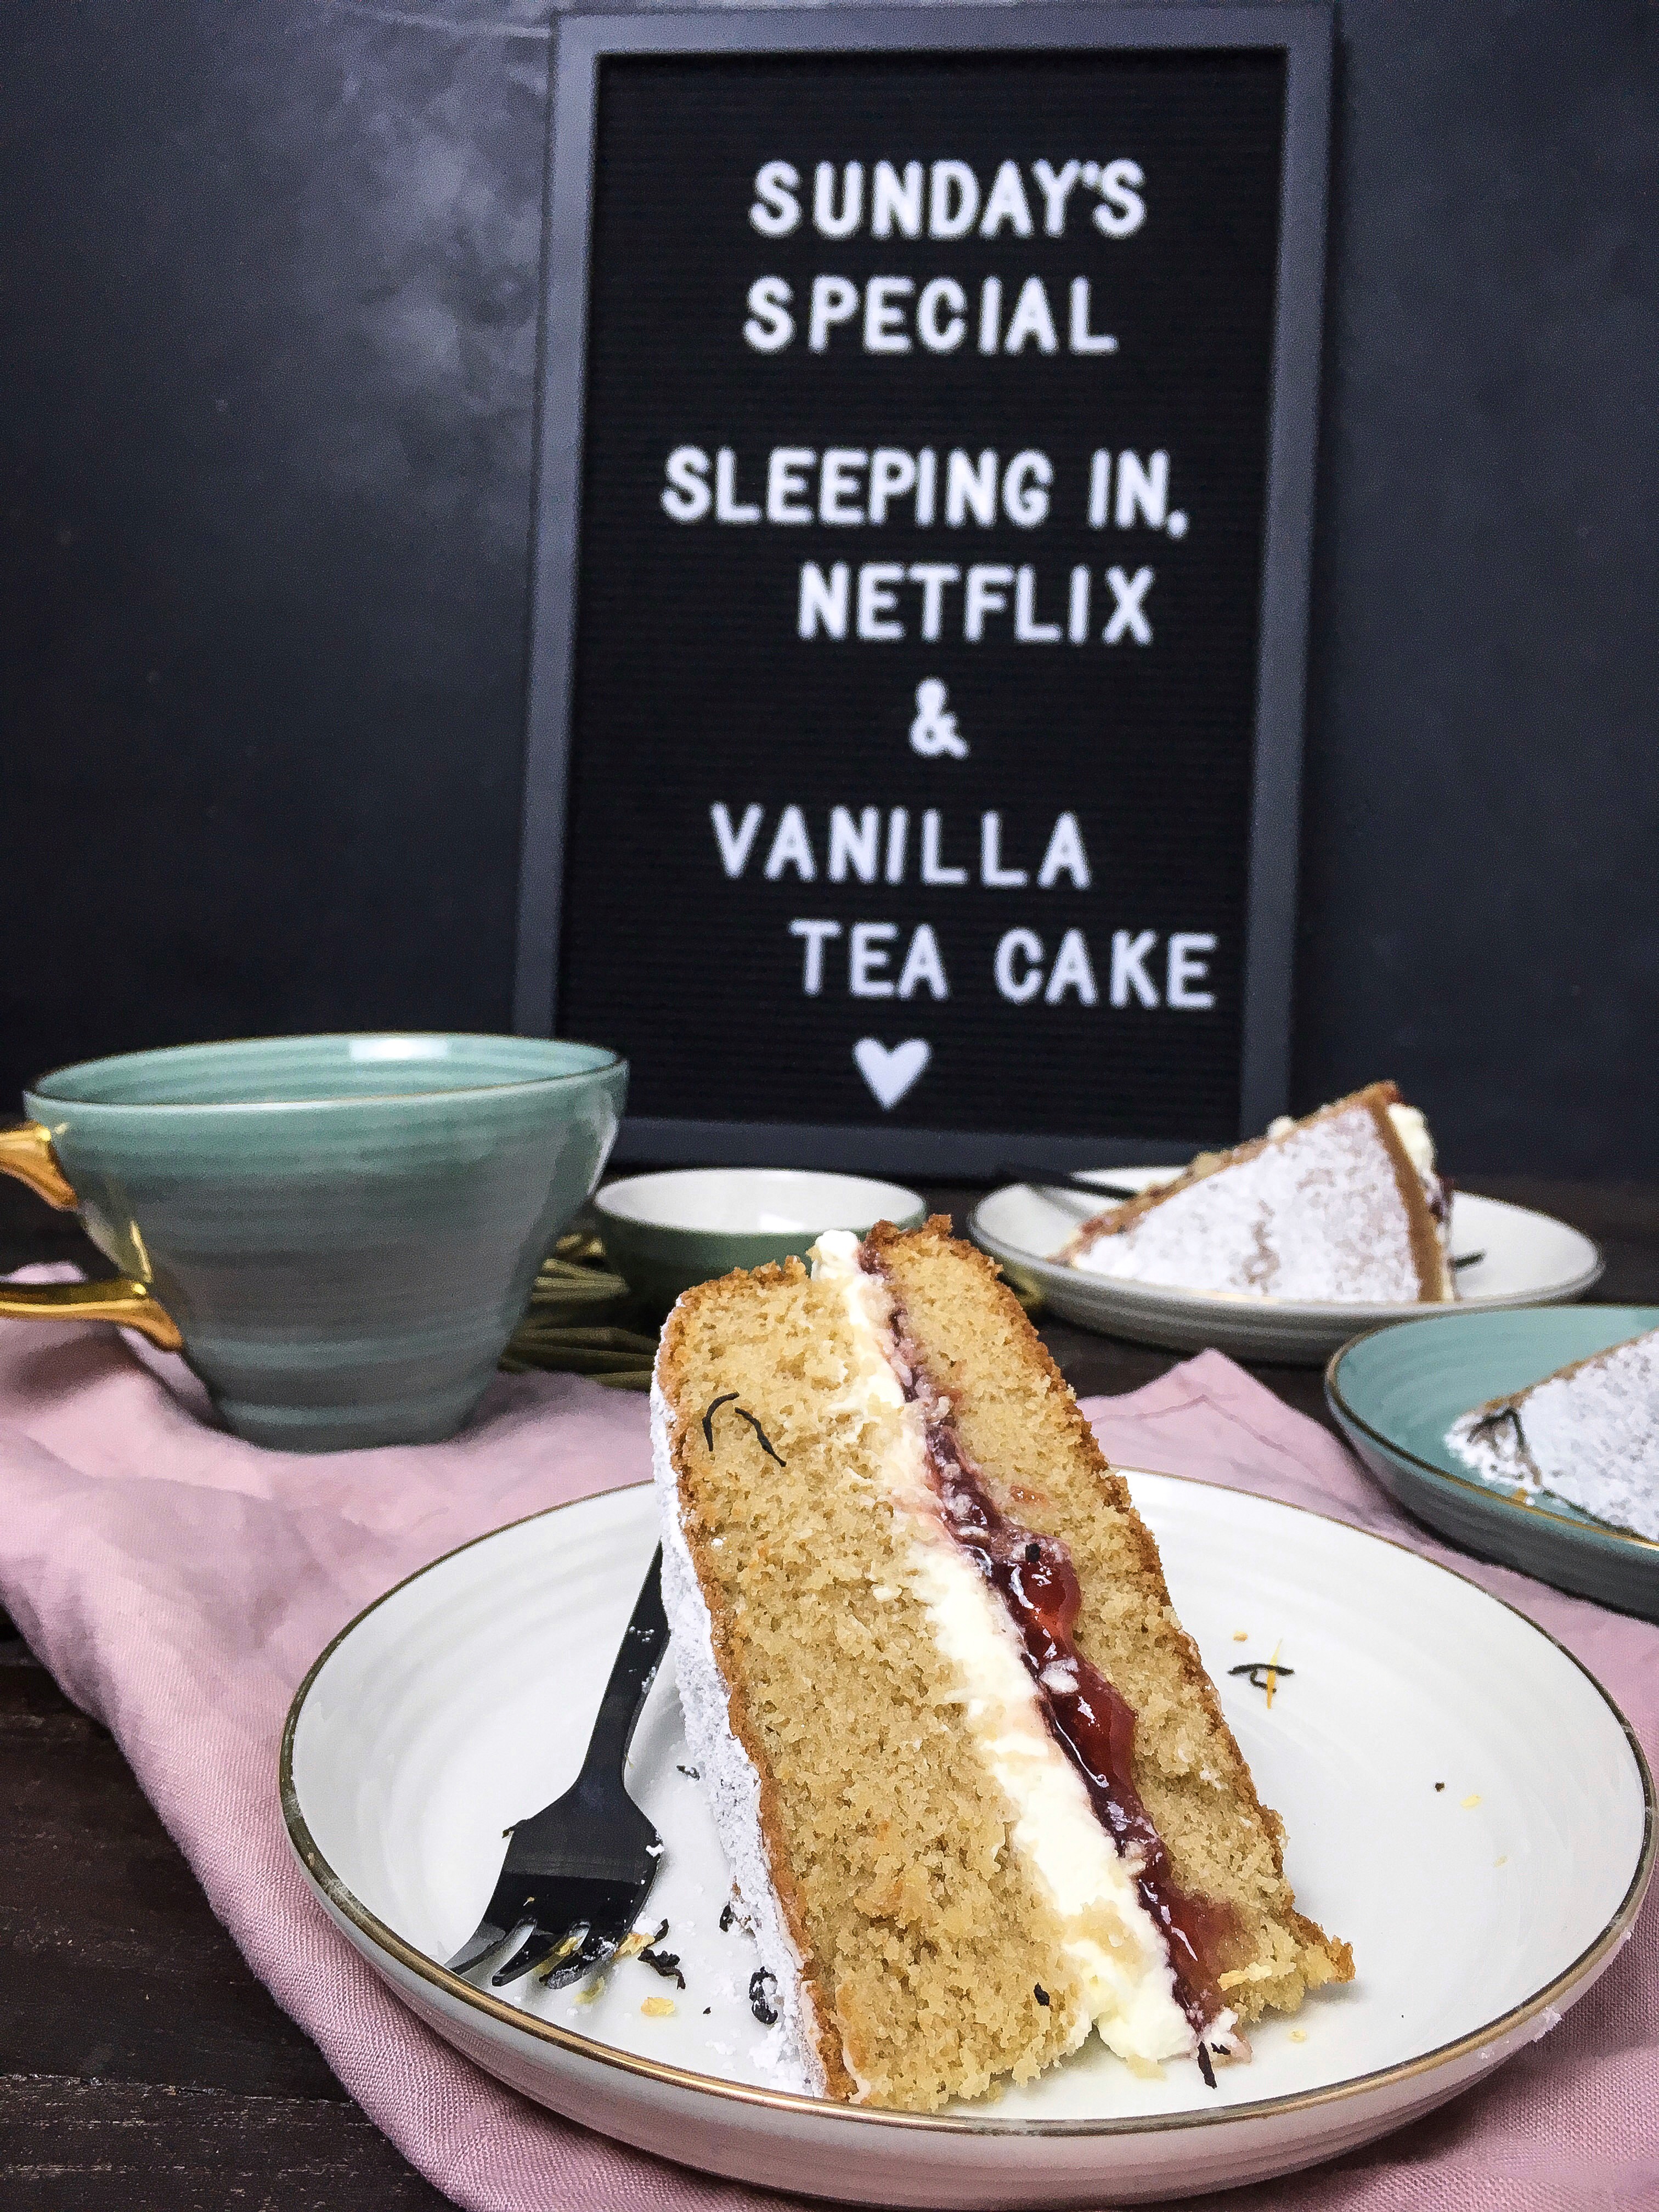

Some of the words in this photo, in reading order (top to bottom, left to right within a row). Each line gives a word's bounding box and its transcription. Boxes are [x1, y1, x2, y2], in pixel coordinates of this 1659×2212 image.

[749, 158, 1147, 239] SUNDAY'S
[742, 274, 1119, 354] SPECIAL
[660, 444, 1055, 528] SLEEPING
[797, 561, 1155, 646] NETFLIX
[908, 676, 968, 759] &
[709, 802, 1091, 889] VANILLA
[789, 918, 949, 1000] TEA
[994, 928, 1218, 1010] CAKE
